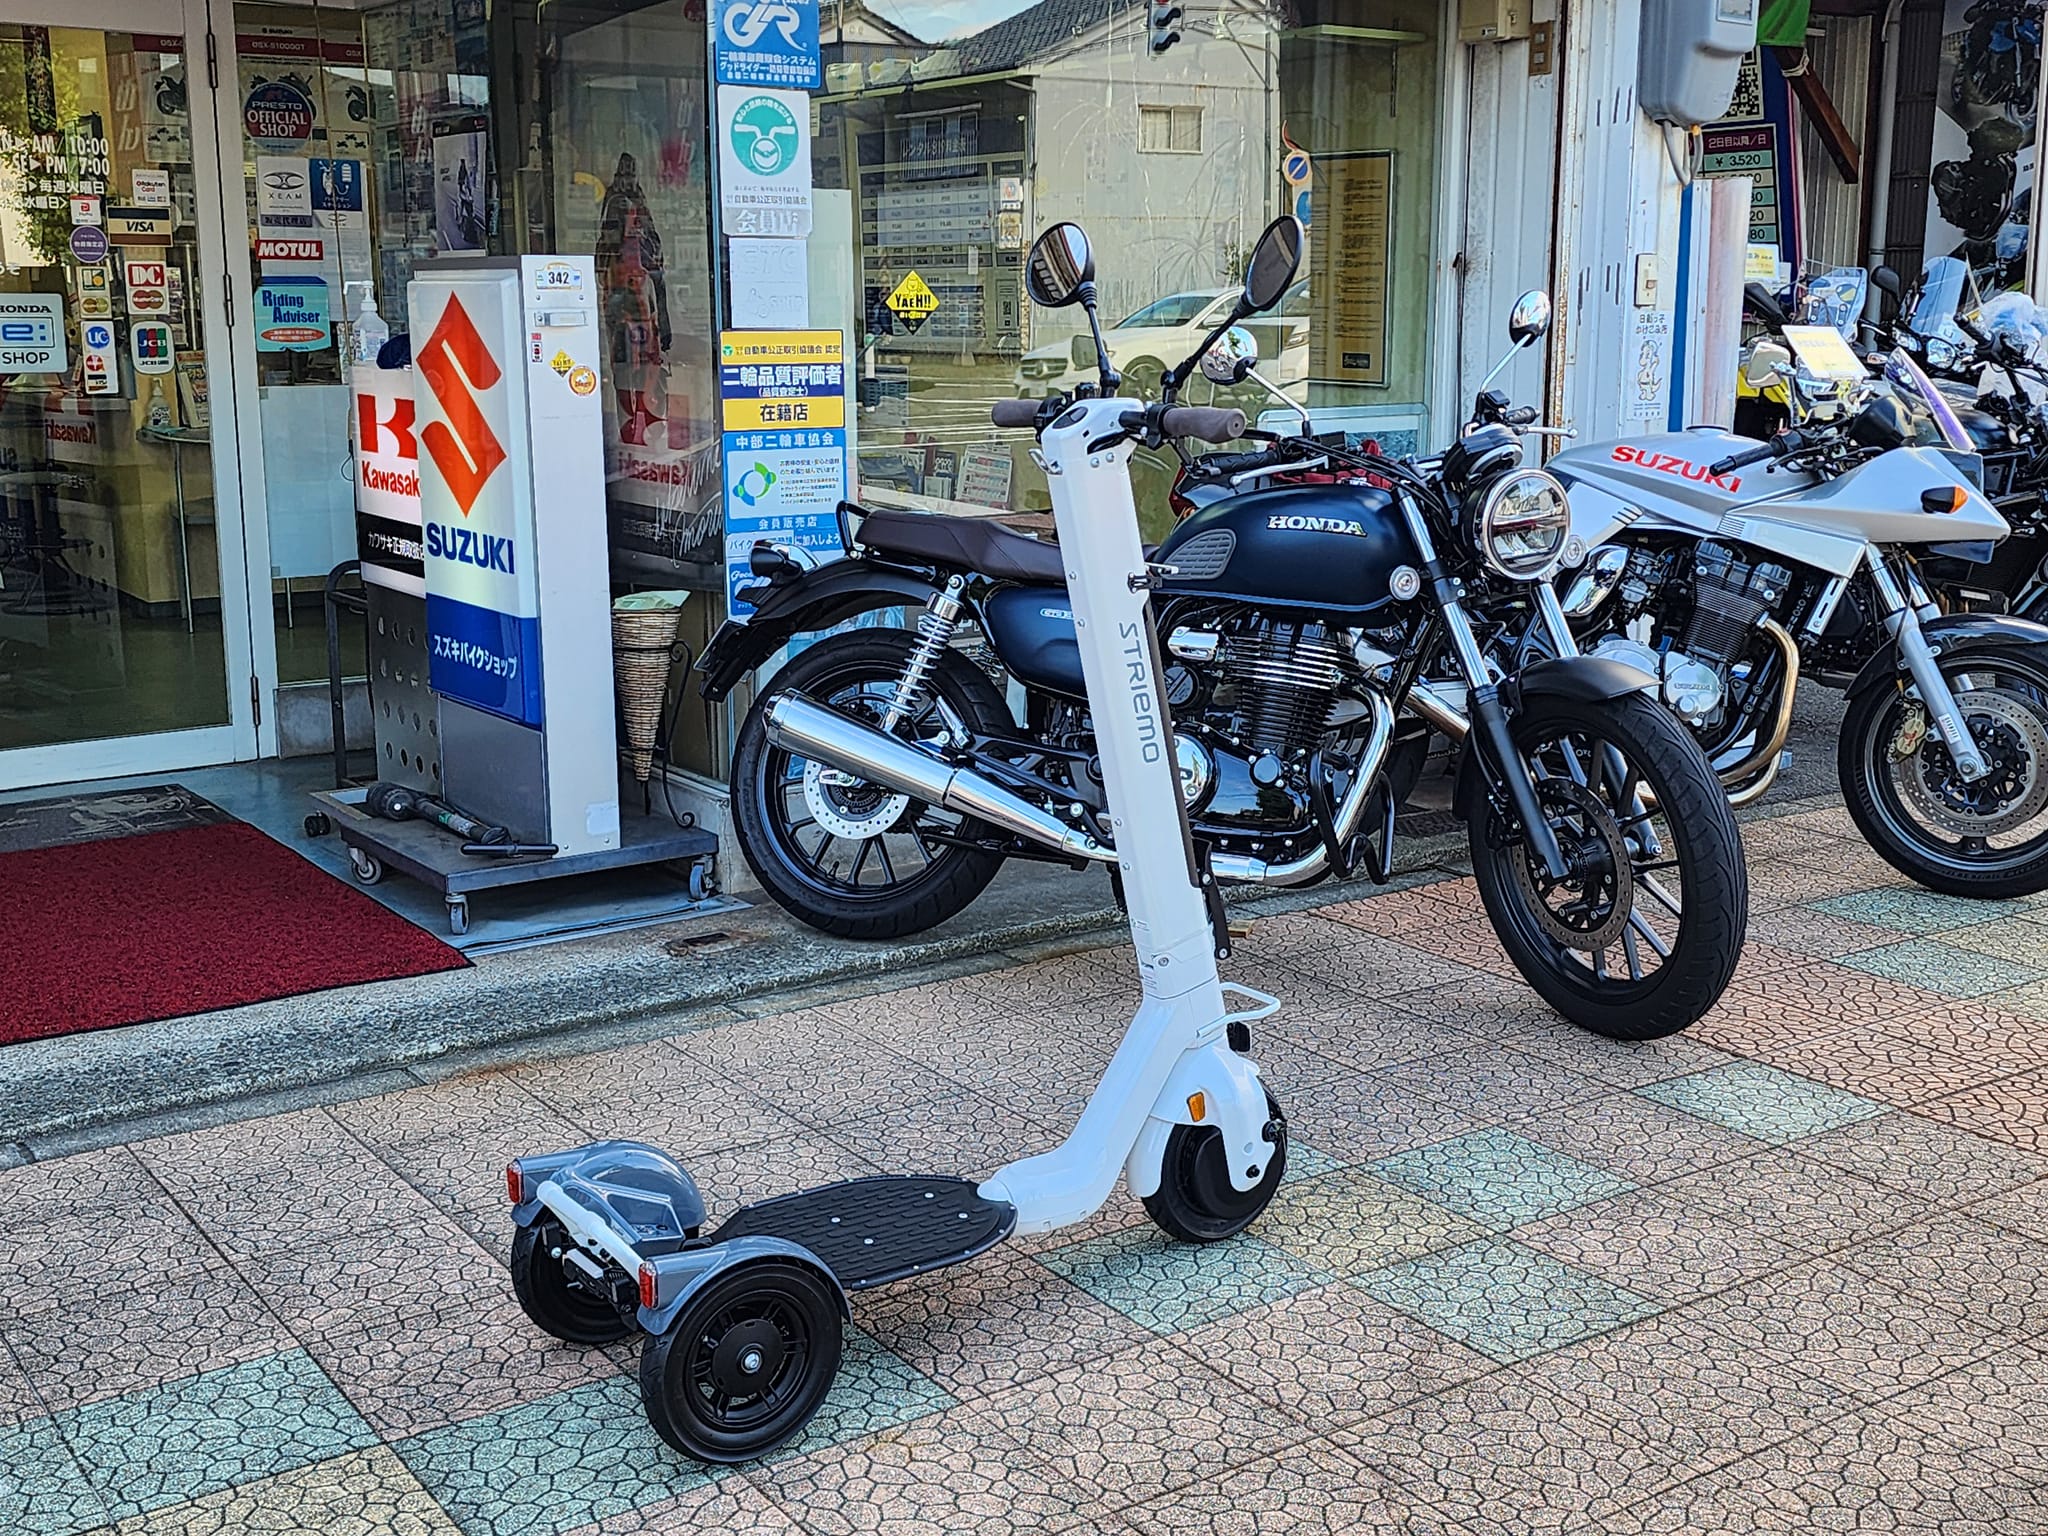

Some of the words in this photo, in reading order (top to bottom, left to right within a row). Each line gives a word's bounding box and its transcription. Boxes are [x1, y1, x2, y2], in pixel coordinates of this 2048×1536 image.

[251, 100, 303, 110] PRESTO
[246, 109, 308, 126] OFFICIAL
[259, 123, 297, 138] SHOP
[79, 156, 110, 176] 7:00
[268, 192, 303, 200] XEAM
[126, 220, 155, 232] VISA
[257, 241, 320, 258] MOTUL
[132, 265, 162, 286] DC
[547, 271, 571, 286] 342
[261, 289, 305, 309] Riding
[271, 306, 321, 324] Adviser
[87, 331, 110, 345] UC
[138, 339, 167, 347] JCB
[2, 351, 50, 365] SHOP
[723, 365, 842, 388] 二輪品質評価者
[760, 403, 809, 423] 在籍店
[736, 432, 834, 450] 中部二輪車協会
[361, 460, 421, 498] Kawasak
[1611, 446, 1742, 494] SUZUKI
[758, 516, 817, 530] 会員販売店
[1266, 515, 1367, 536] HONDA
[426, 522, 515, 575] SUZUKI
[433, 633, 518, 680] スズキバイクショップ
